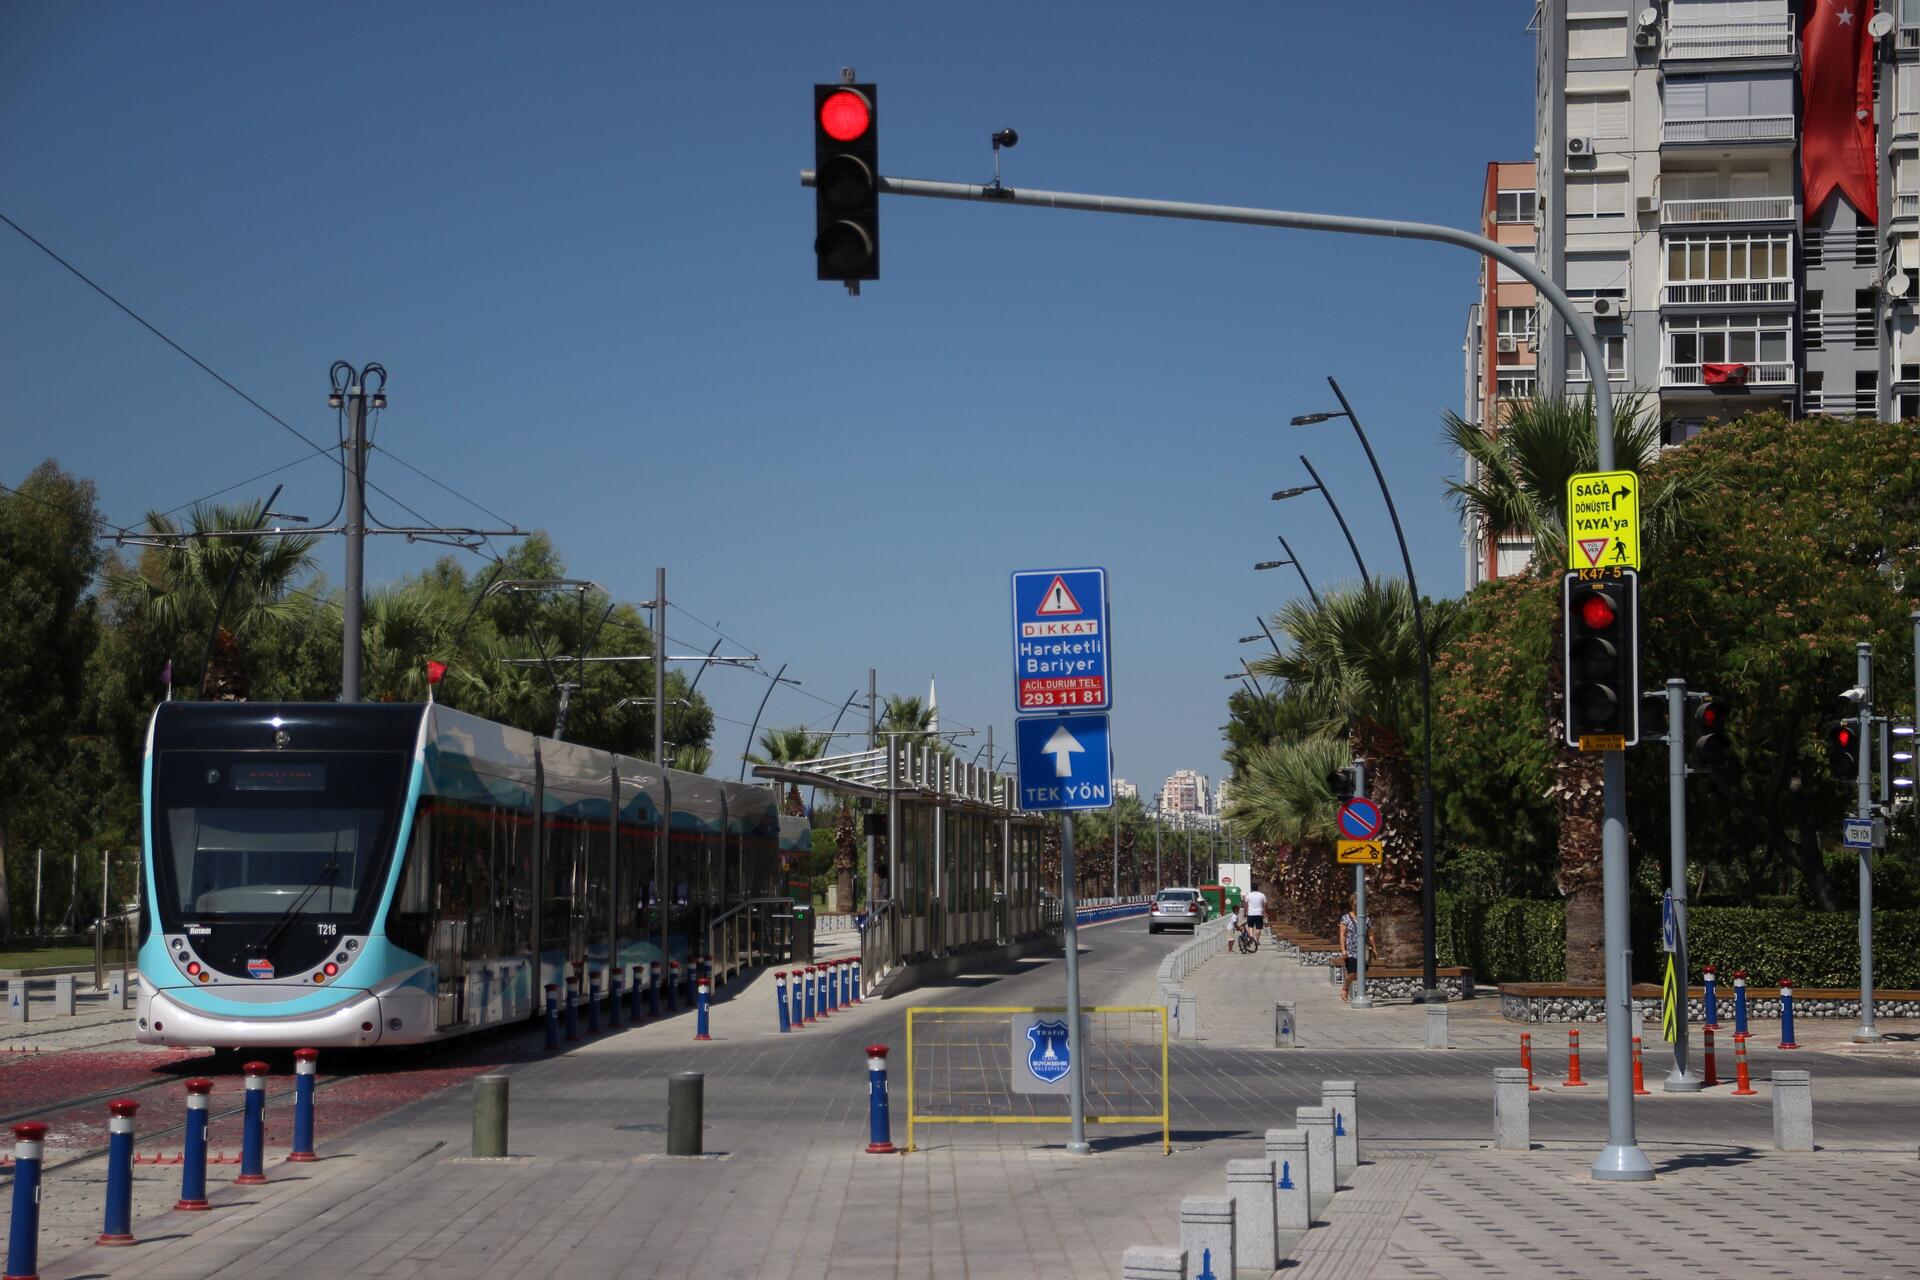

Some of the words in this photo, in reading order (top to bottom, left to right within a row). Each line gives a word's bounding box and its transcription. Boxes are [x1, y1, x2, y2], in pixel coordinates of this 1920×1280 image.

[1576, 500, 1610, 514] DÖNÜŞTE
[1576, 517, 1628, 531] YAYA'ya
[1021, 640, 1101, 656] Hareketli
[1027, 659, 1095, 675] Bariyer
[1025, 679, 1044, 689] ACİL
[1046, 680, 1076, 689] DURUM
[1078, 678, 1100, 688] TEL:
[1024, 693, 1054, 705] 293
[1060, 692, 1077, 704] 11
[1083, 691, 1102, 703] 81
[1026, 787, 1060, 802] TEK
[1066, 782, 1105, 800] YÖN
[1851, 829, 1859, 838] TEK
[318, 924, 337, 935] T216
